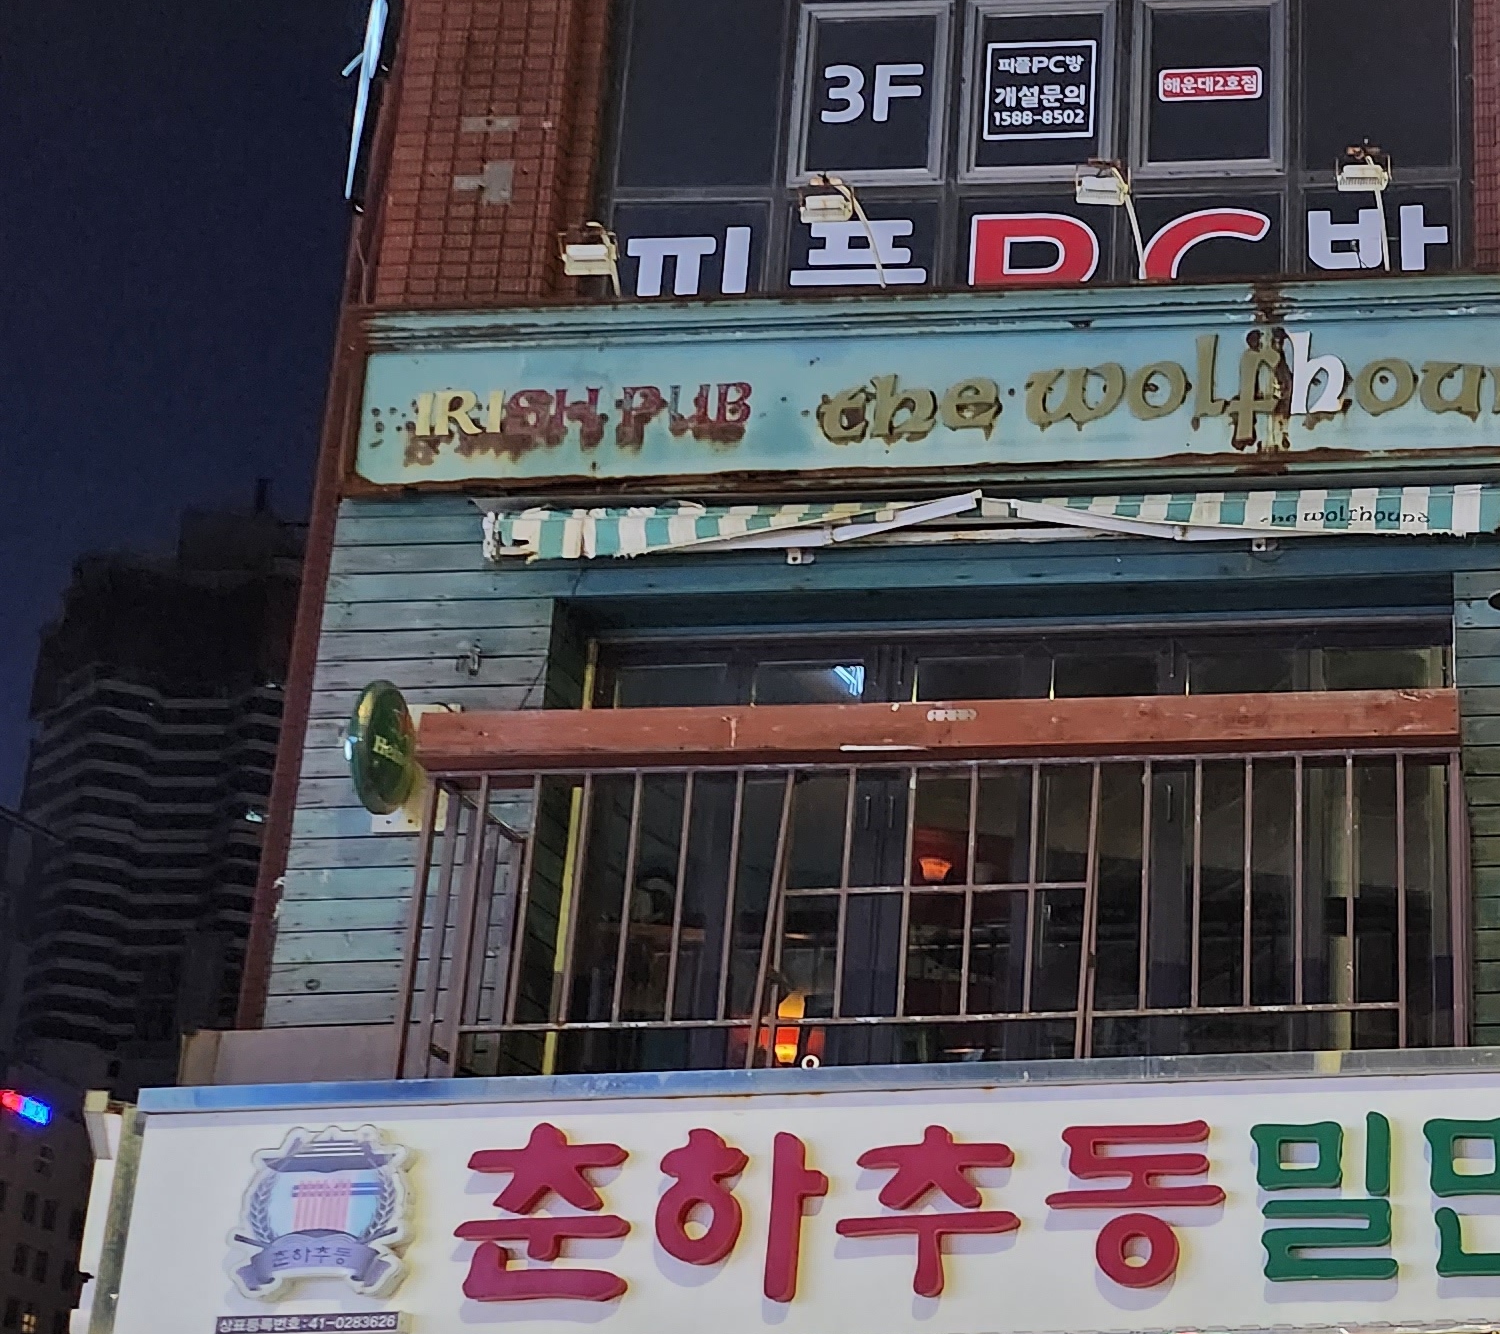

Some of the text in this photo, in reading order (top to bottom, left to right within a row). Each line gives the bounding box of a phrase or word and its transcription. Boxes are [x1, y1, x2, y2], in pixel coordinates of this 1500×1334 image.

[998, 54, 1085, 74] 피플PC방
[820, 63, 924, 124] 3F
[1162, 74, 1258, 94] 해운대2호점
[994, 83, 1086, 108] 개설문의
[993, 108, 1085, 126] 1588-8502
[817, 371, 1003, 443] the
